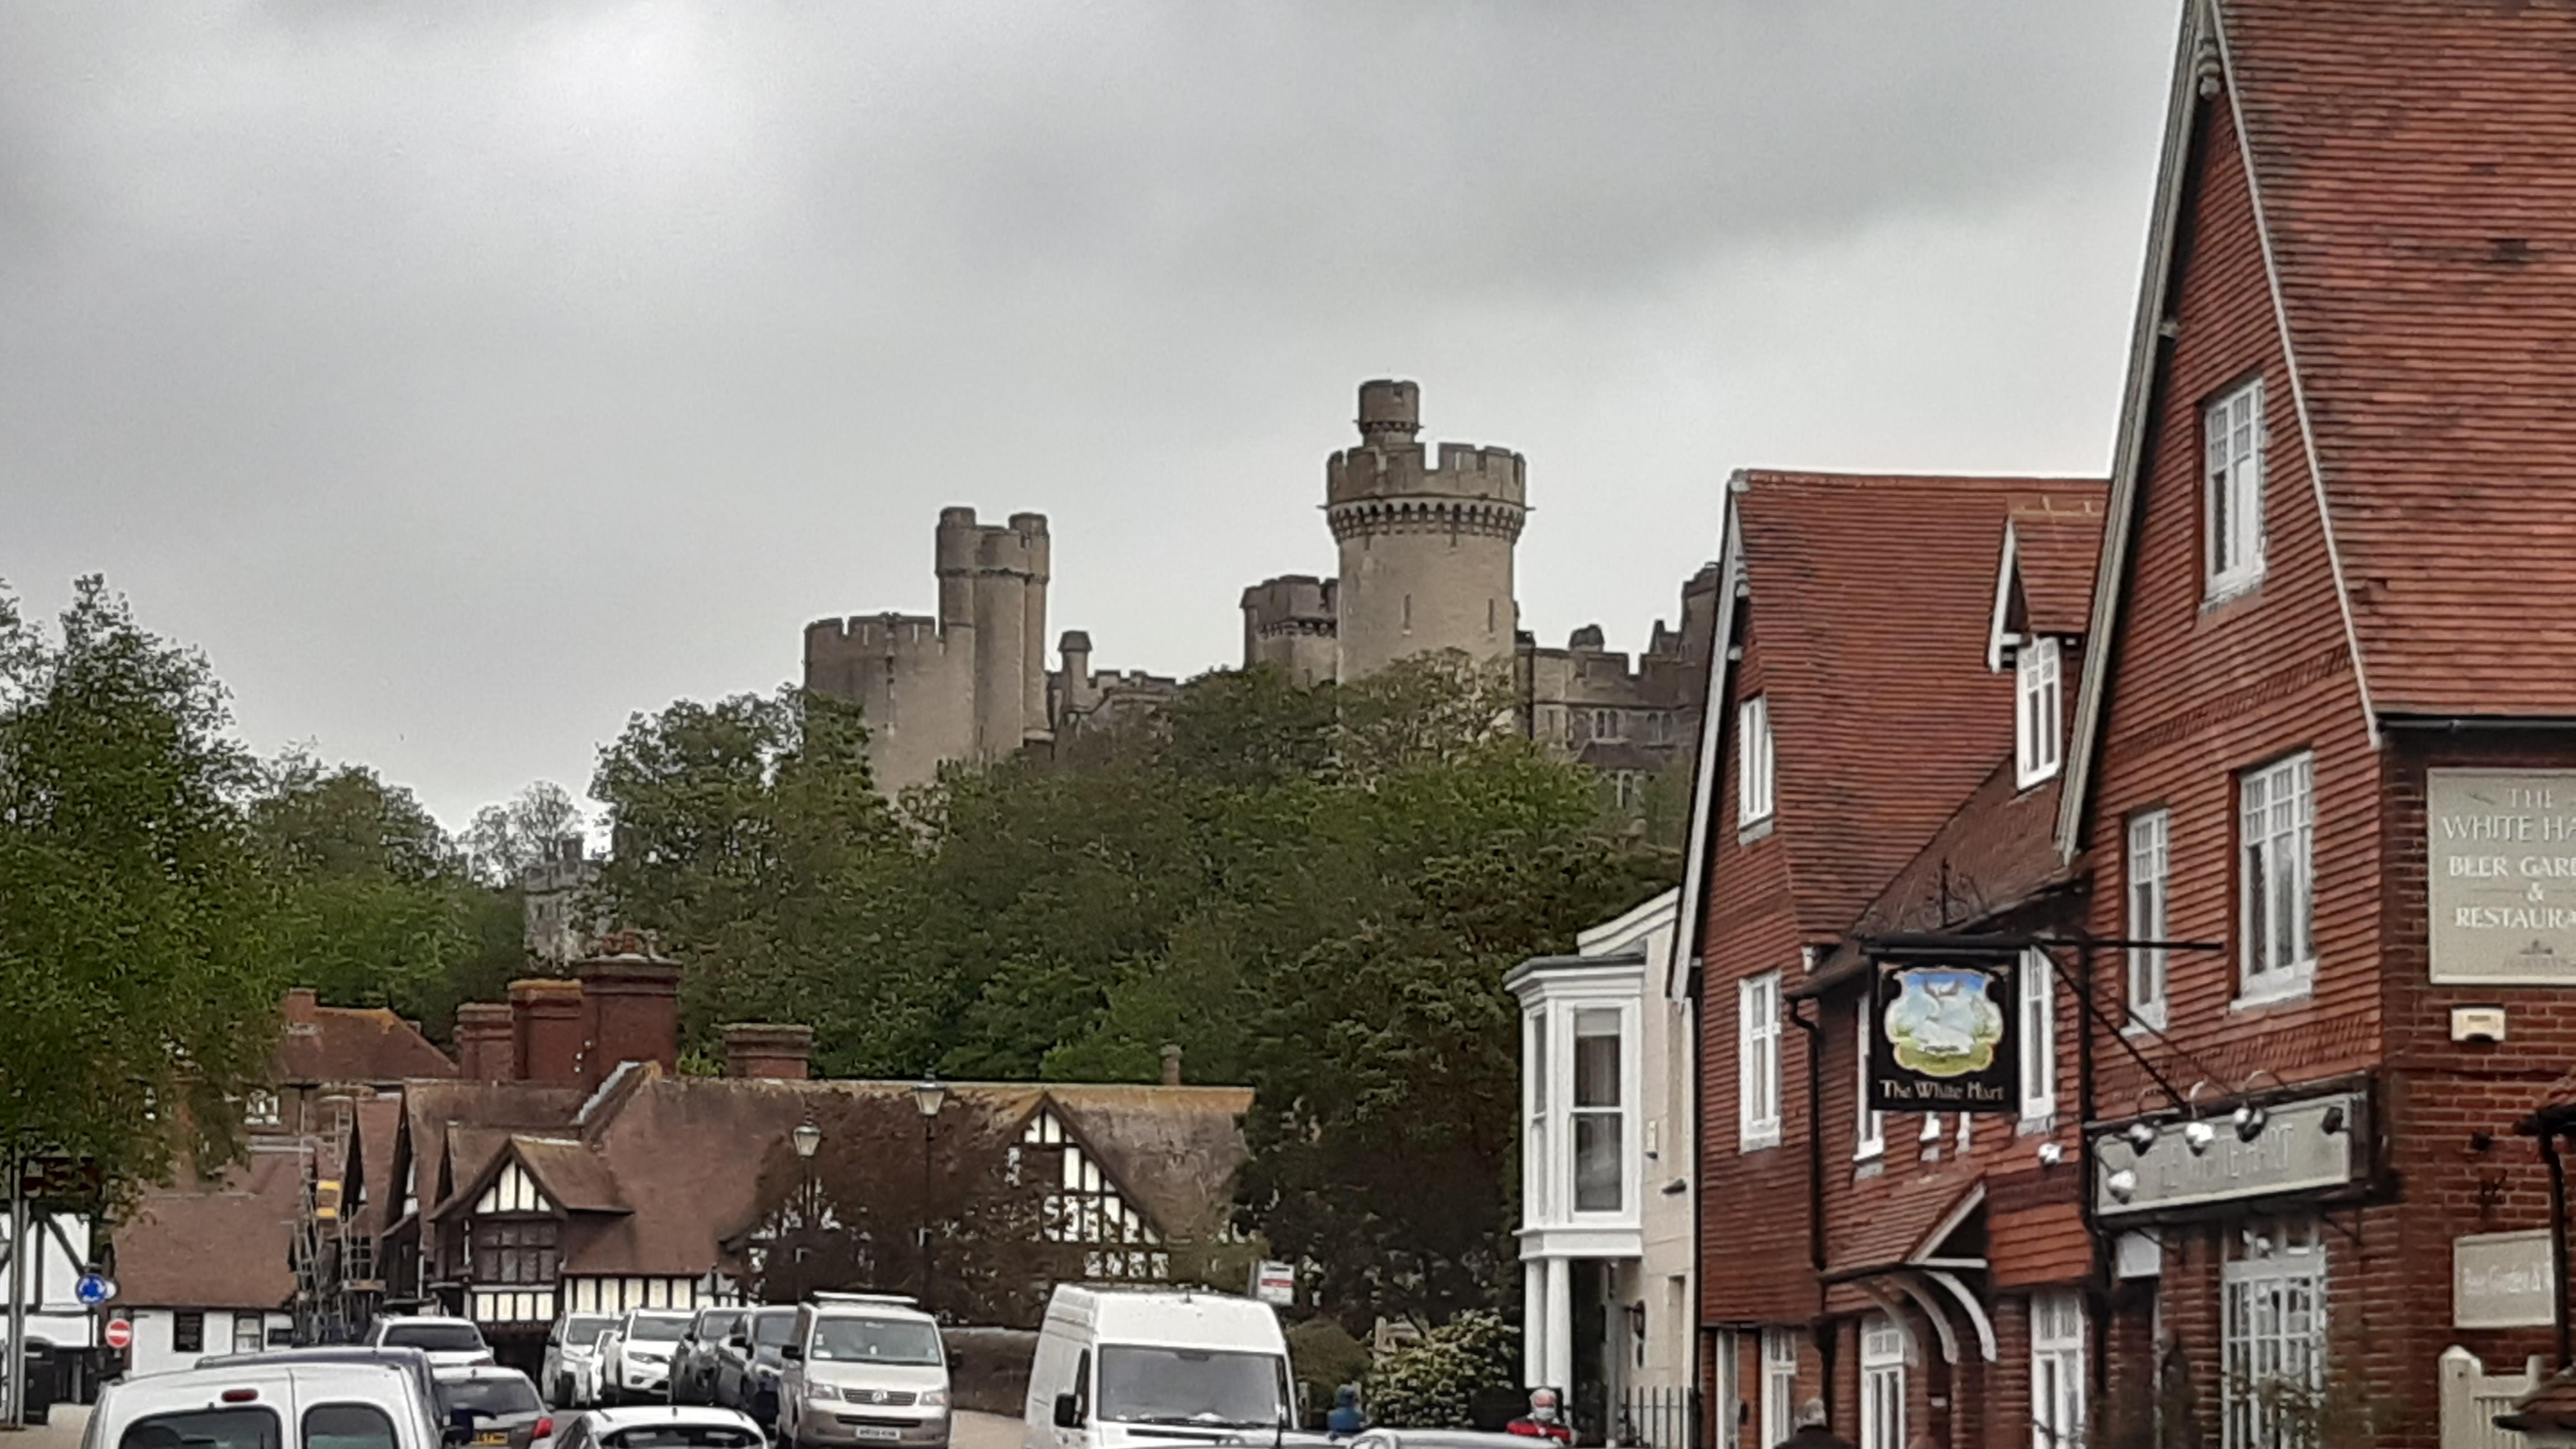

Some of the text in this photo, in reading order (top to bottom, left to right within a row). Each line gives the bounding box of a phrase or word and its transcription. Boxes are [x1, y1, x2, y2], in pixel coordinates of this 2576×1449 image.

[2506, 787, 2553, 809] THE
[2442, 815, 2532, 841] WHITE
[2449, 856, 2509, 876] BEER
[2527, 882, 2544, 902] &
[1879, 1080, 2005, 1101] The White Hart
